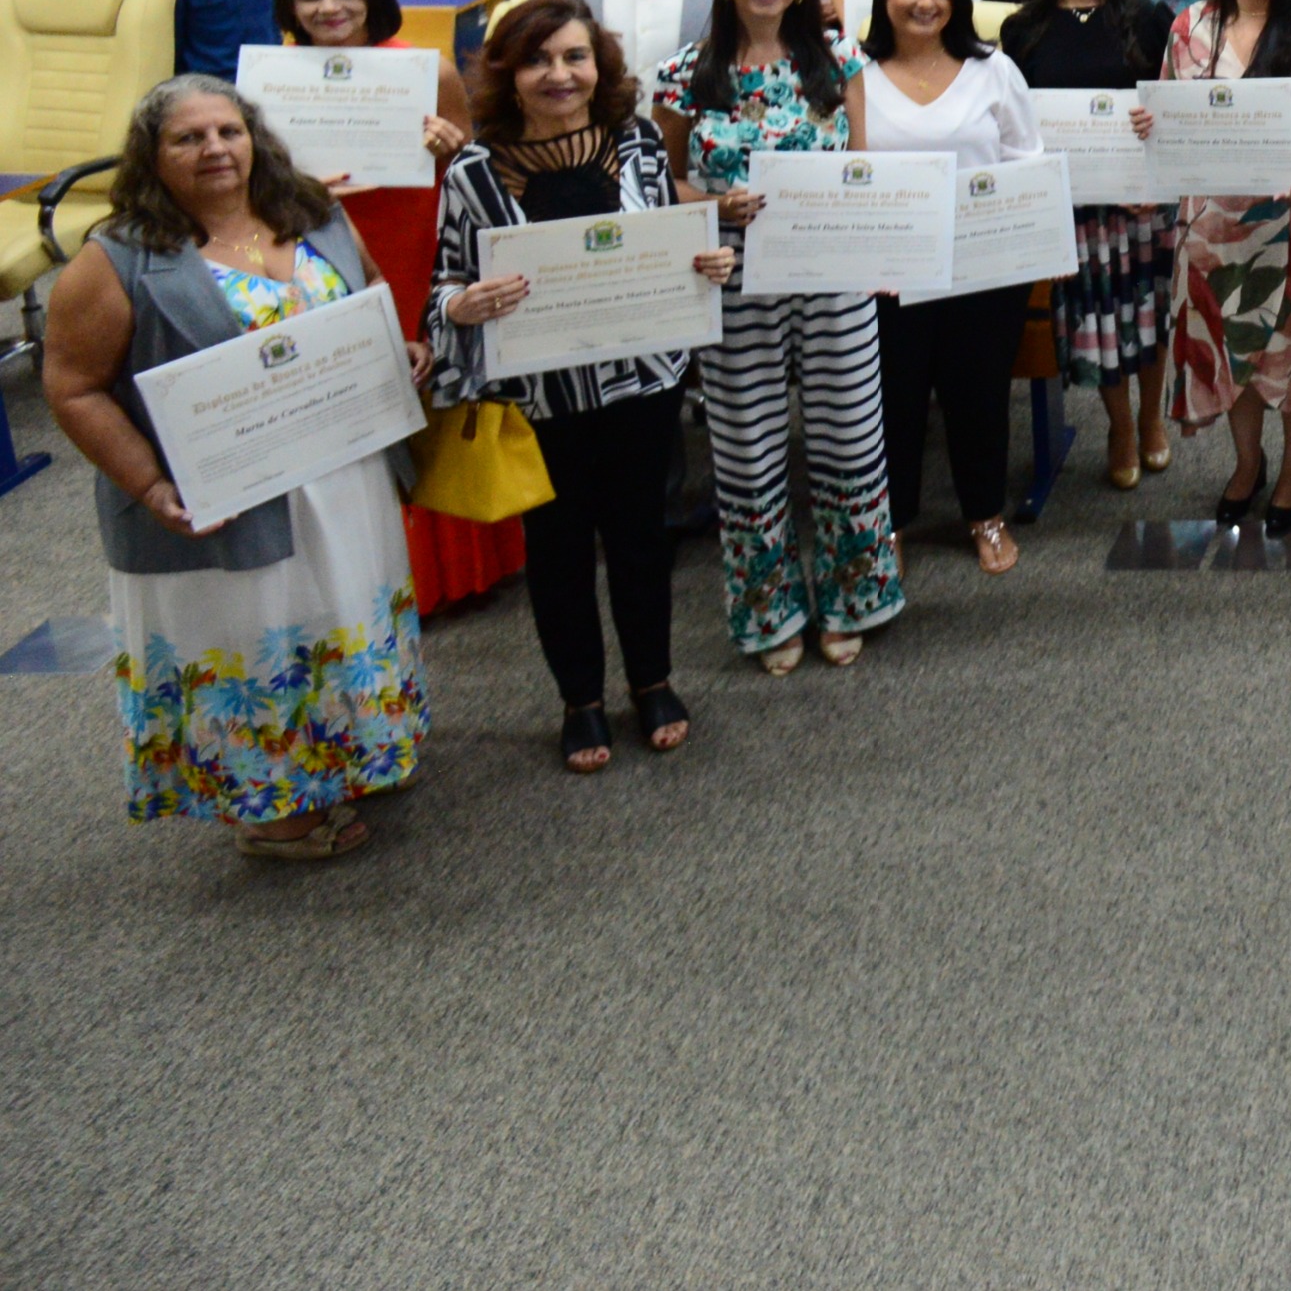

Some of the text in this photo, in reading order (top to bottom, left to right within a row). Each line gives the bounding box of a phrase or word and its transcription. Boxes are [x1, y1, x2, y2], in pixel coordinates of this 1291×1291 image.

[262, 84, 305, 94] Diploma
[324, 85, 356, 93] Honra
[1211, 110, 1238, 118] Honra
[778, 189, 824, 199] Diploma
[828, 190, 838, 198] de
[843, 189, 877, 198] Honra
[895, 189, 929, 198] Mérito
[959, 203, 968, 211] de
[972, 197, 1002, 208] Honra
[537, 260, 577, 274] Diploma
[579, 259, 590, 267] de
[592, 255, 622, 266] Honra
[191, 336, 372, 414] Diploma de Honra ao Mérito
[266, 414, 278, 424] de
